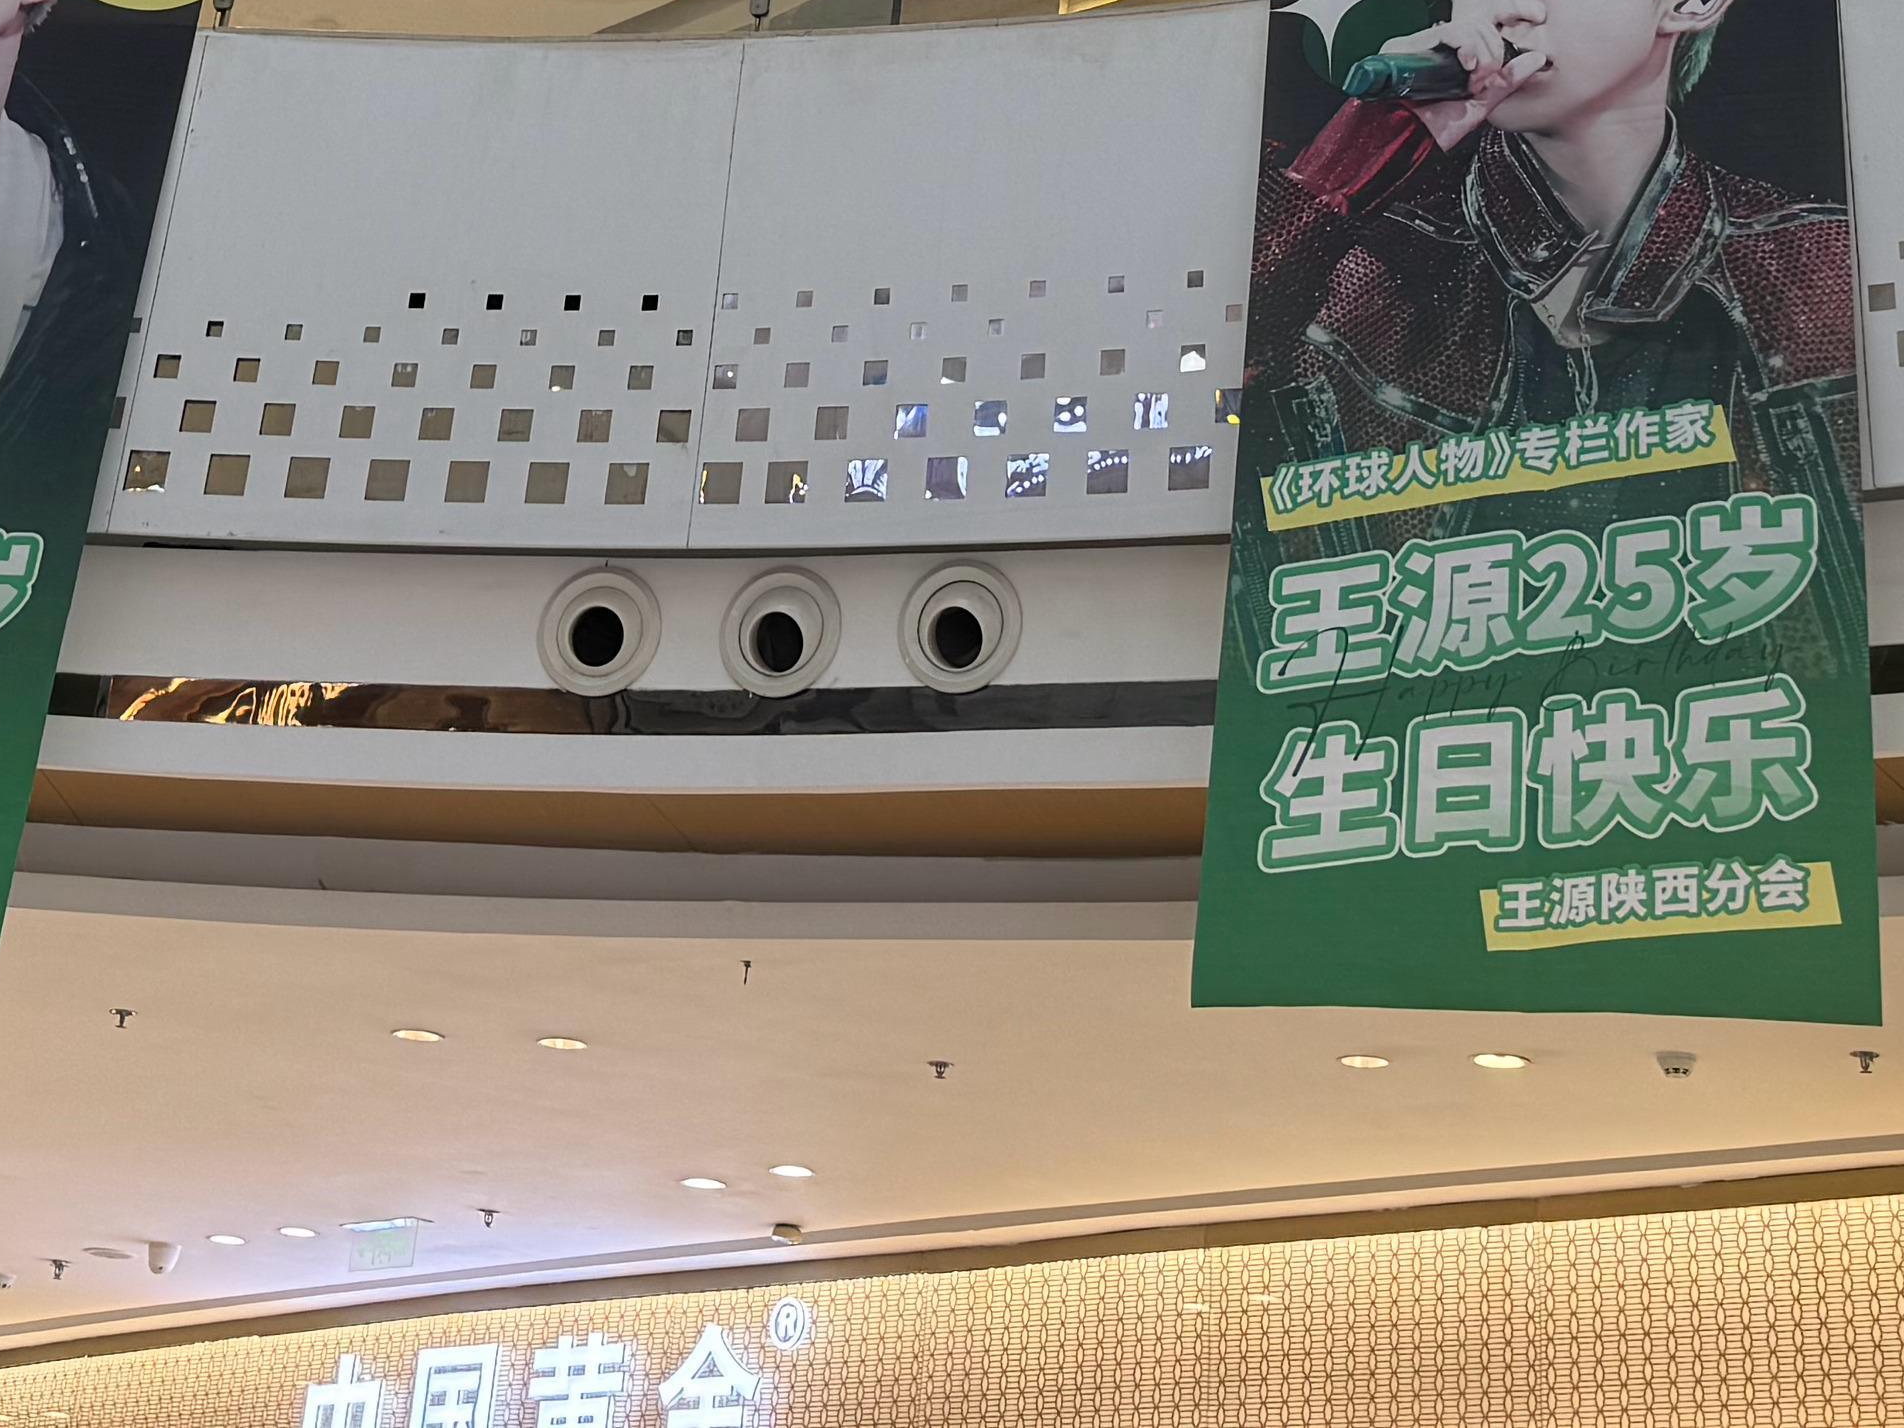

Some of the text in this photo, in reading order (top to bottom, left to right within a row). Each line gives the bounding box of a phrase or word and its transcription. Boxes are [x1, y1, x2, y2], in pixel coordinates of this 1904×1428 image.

[1271, 404, 1715, 510] 《环球人物》专栏作家
[1264, 496, 1815, 690] 王源25岁
[1261, 678, 1814, 869] 生日快乐
[1497, 865, 1808, 929] 王源陕西分会
